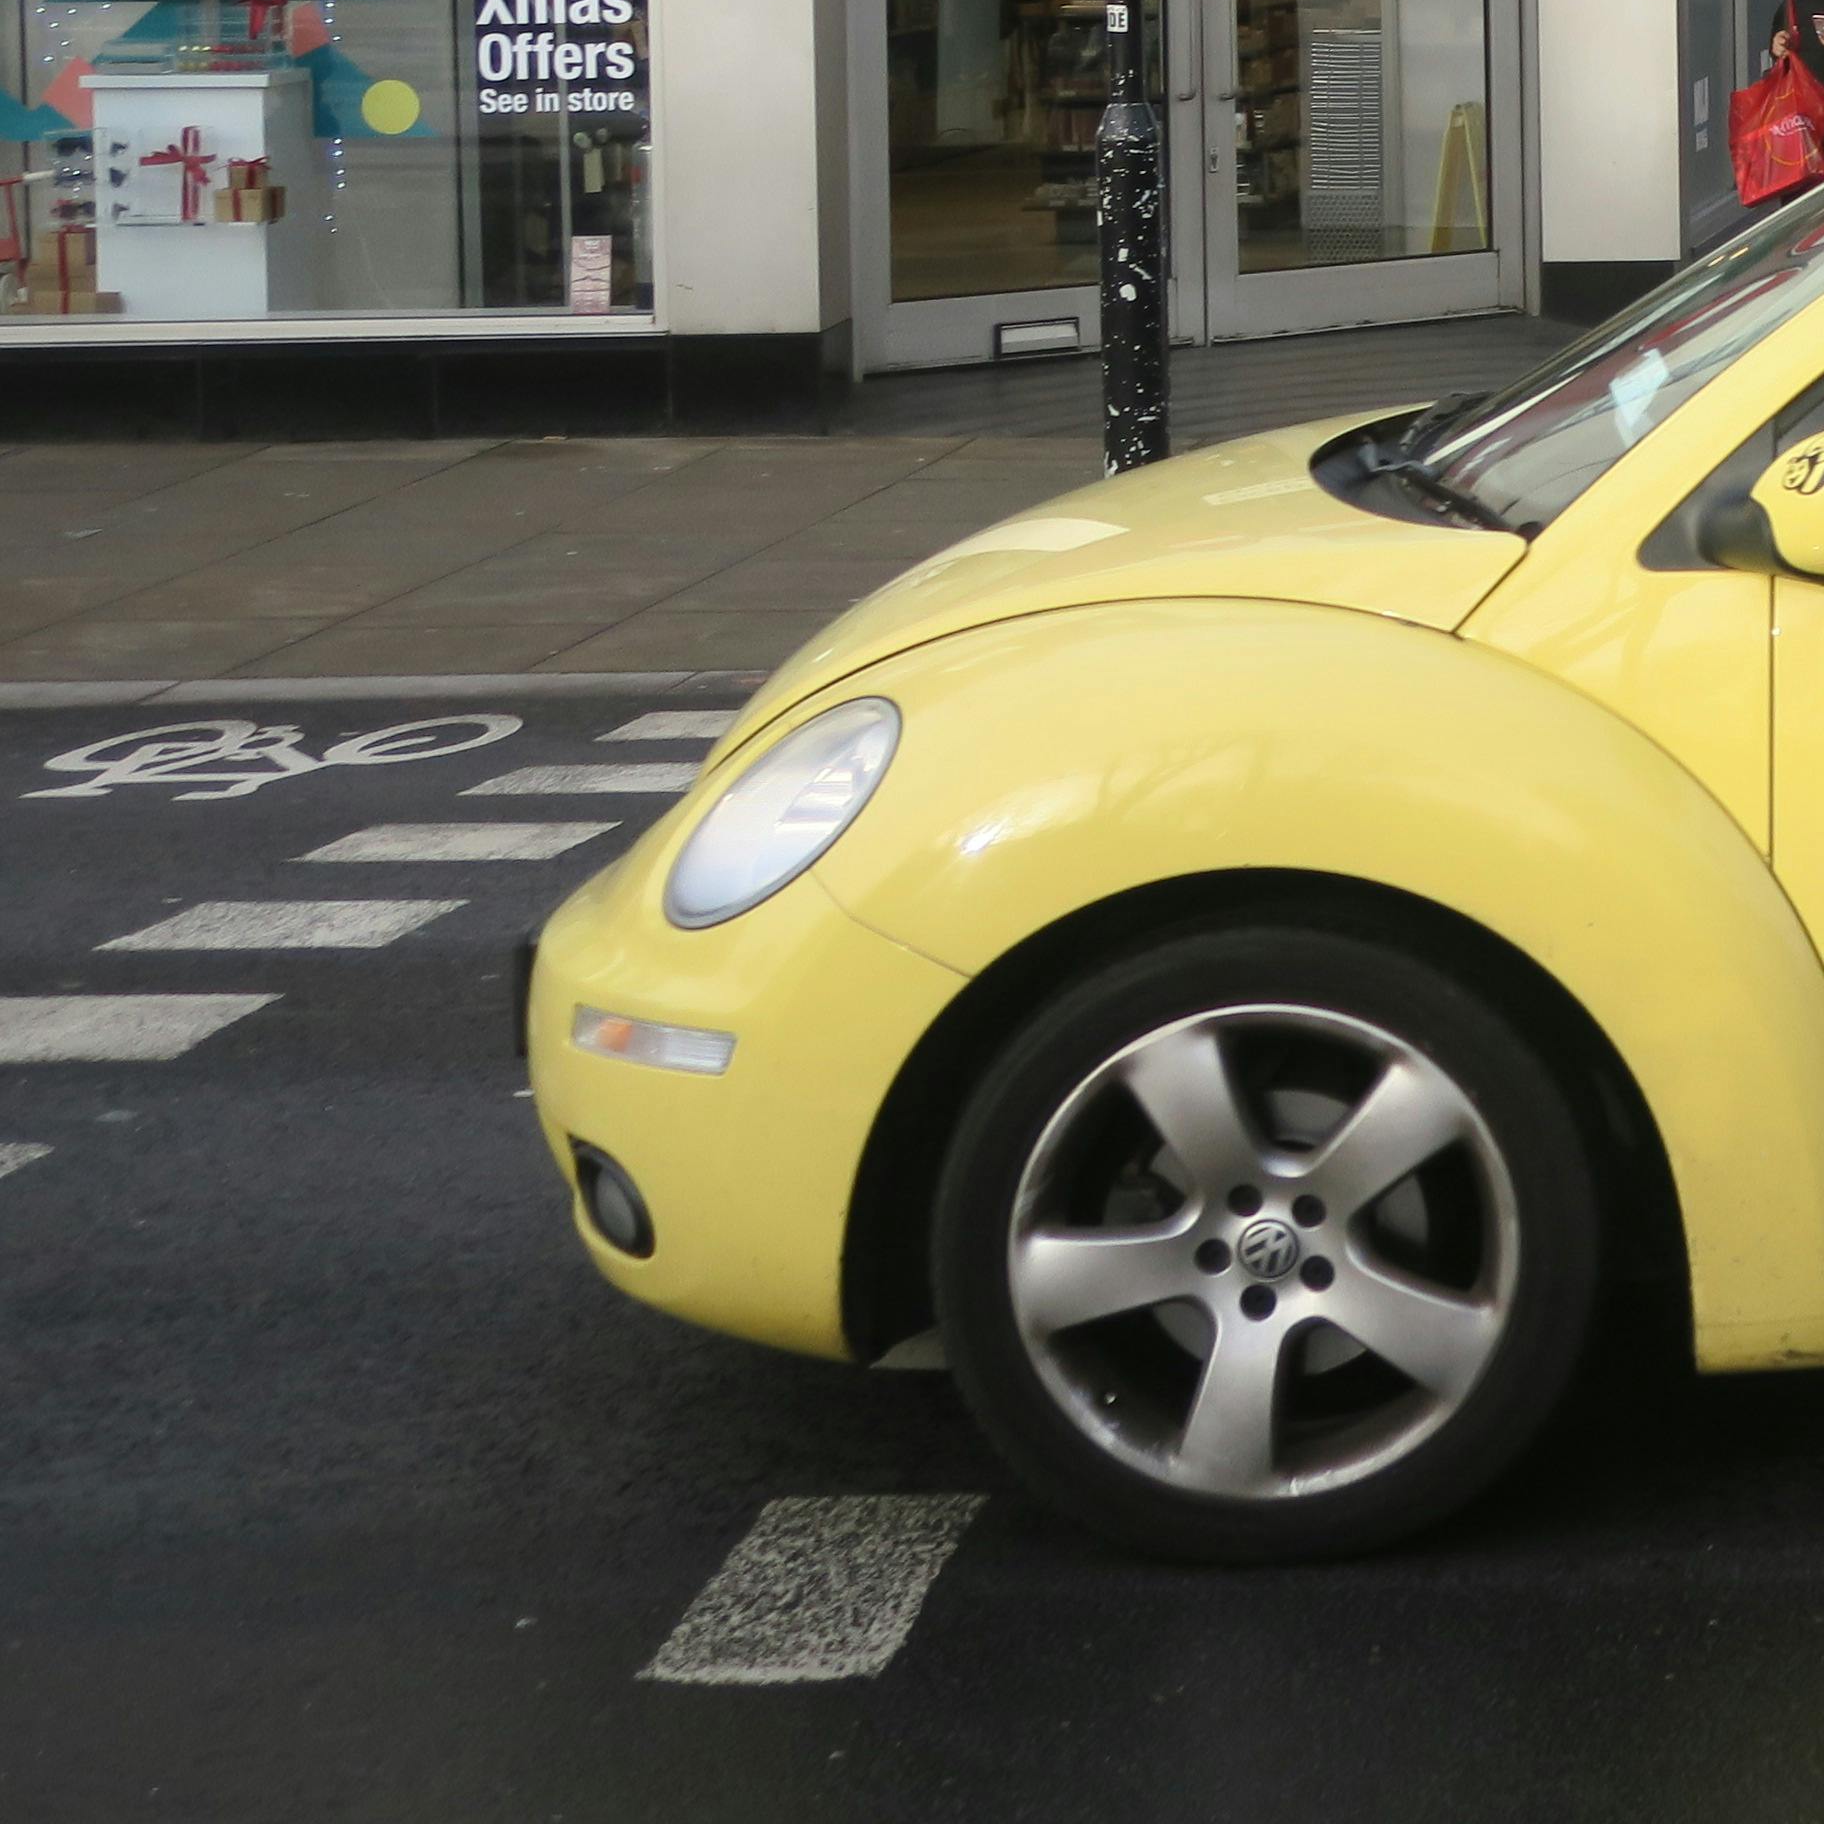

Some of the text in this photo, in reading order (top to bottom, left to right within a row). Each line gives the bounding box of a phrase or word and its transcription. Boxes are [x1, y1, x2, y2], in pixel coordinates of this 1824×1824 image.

[477, 31, 635, 82] Offers
[479, 88, 635, 114] See in store
